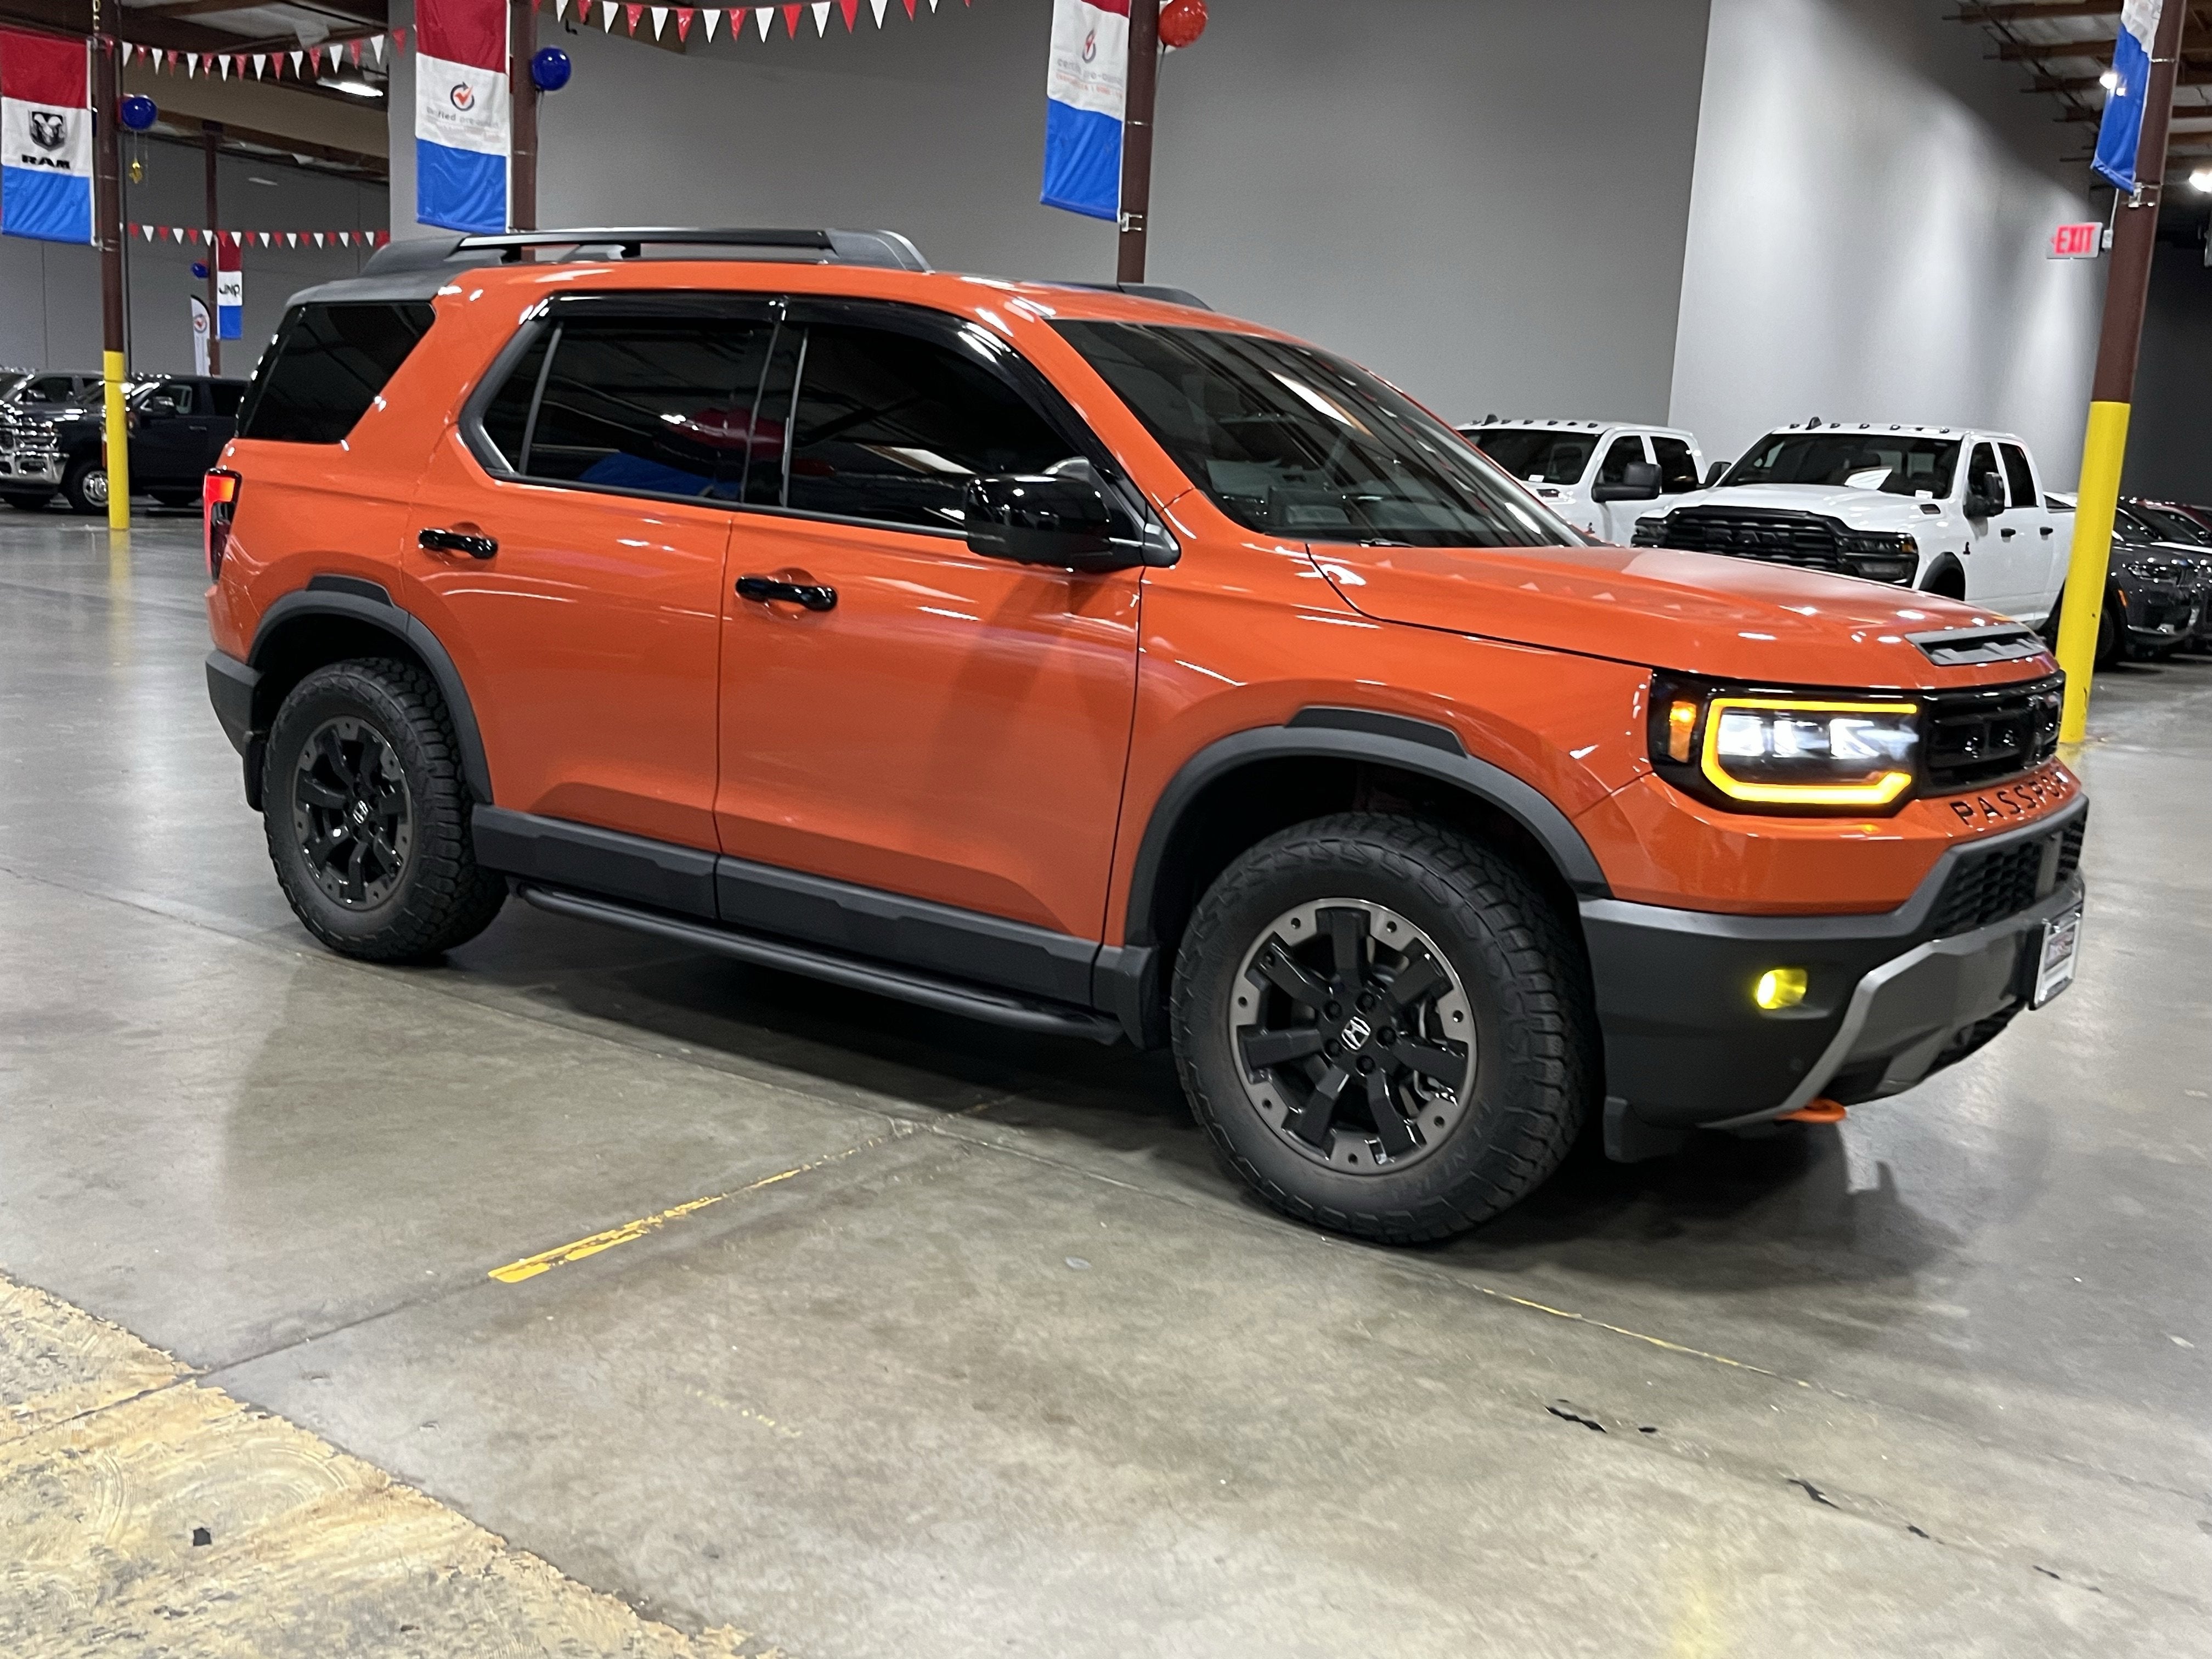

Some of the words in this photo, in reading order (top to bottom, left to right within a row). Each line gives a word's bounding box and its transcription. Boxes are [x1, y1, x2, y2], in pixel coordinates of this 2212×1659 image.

[21, 154, 71, 169] RAM
[2055, 225, 2095, 254] EXIT
[1949, 766, 2069, 826] PASSPO
